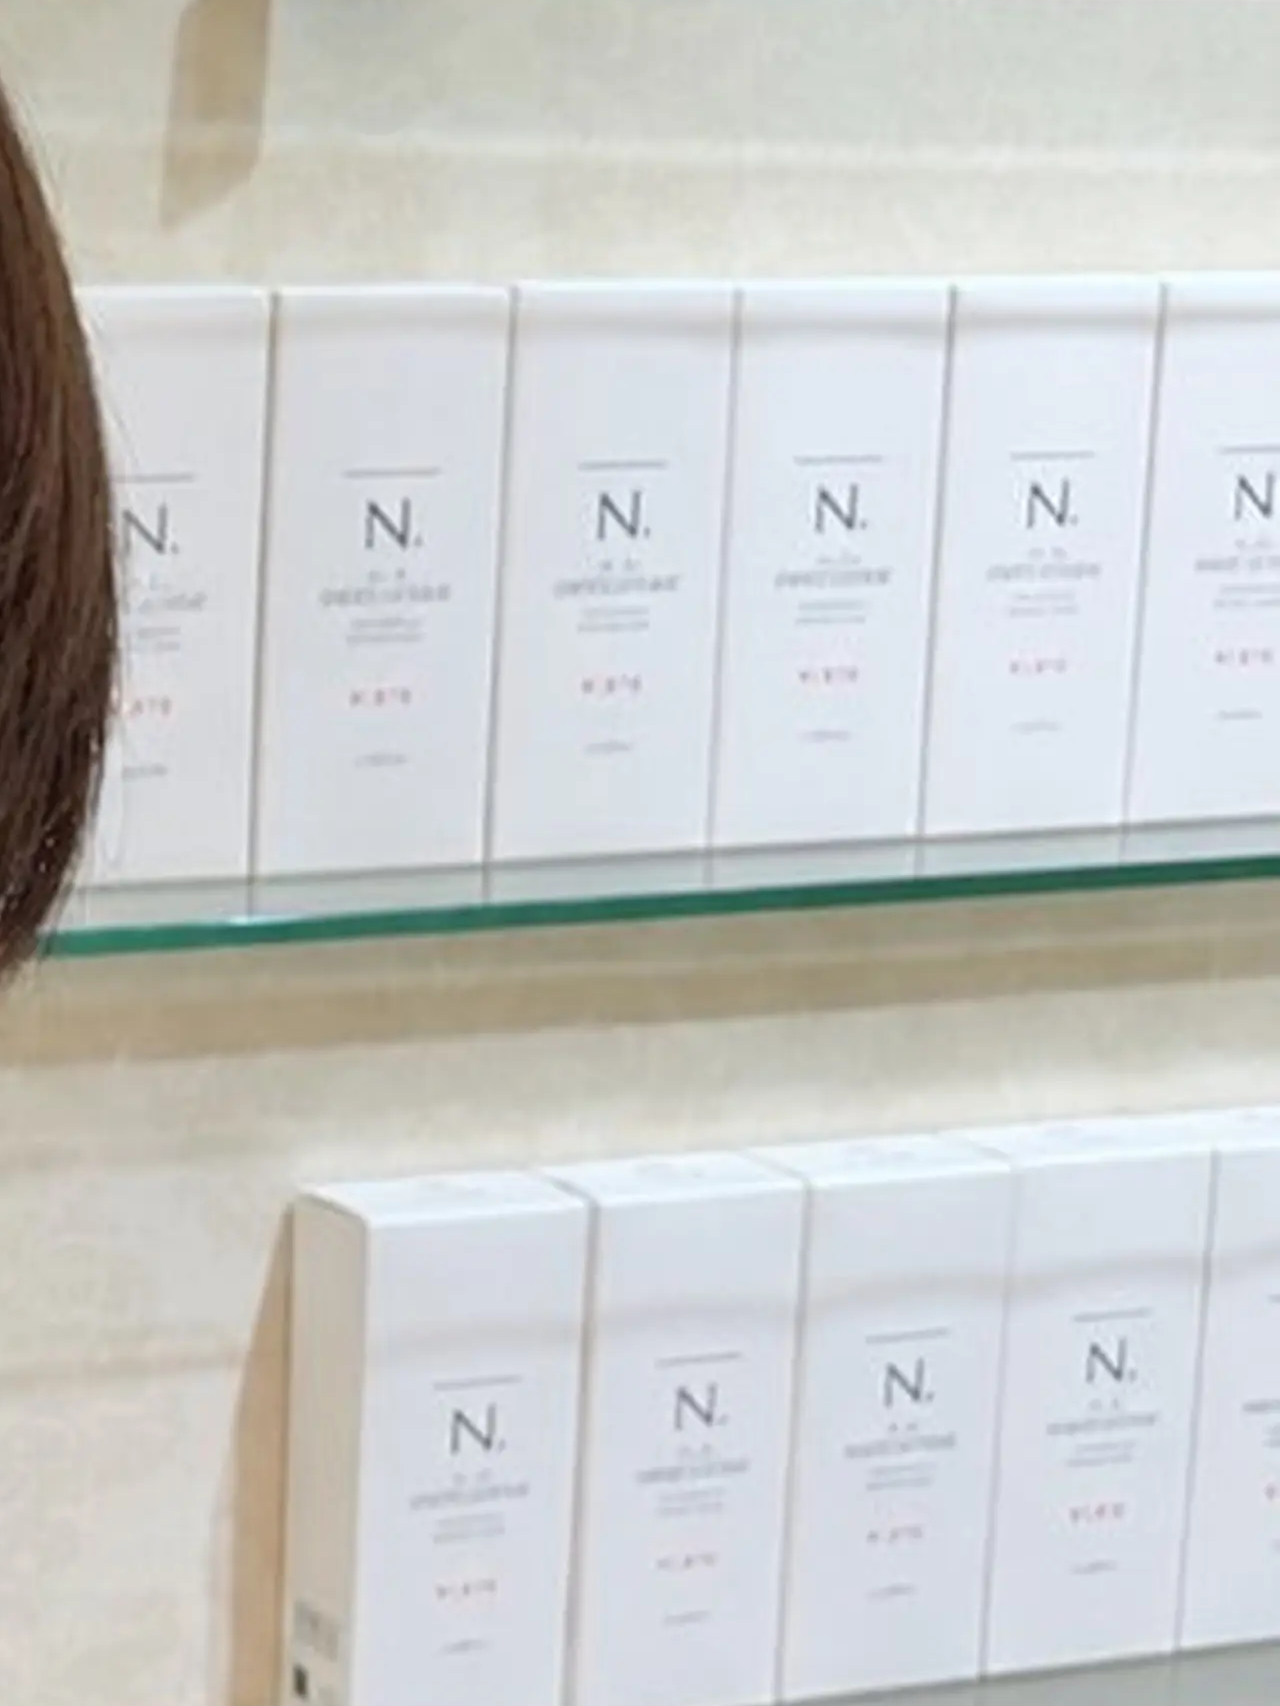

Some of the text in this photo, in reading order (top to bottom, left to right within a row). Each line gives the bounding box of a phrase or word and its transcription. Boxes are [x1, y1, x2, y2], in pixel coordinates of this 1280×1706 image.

[364, 496, 423, 552] N.
[596, 489, 651, 542] N.
[813, 482, 869, 535] N.
[1025, 477, 1079, 530] N.
[883, 1357, 935, 1409] N.
[1085, 1337, 1137, 1386] N.
[449, 1403, 506, 1456] N.
[673, 1383, 727, 1431] N.
